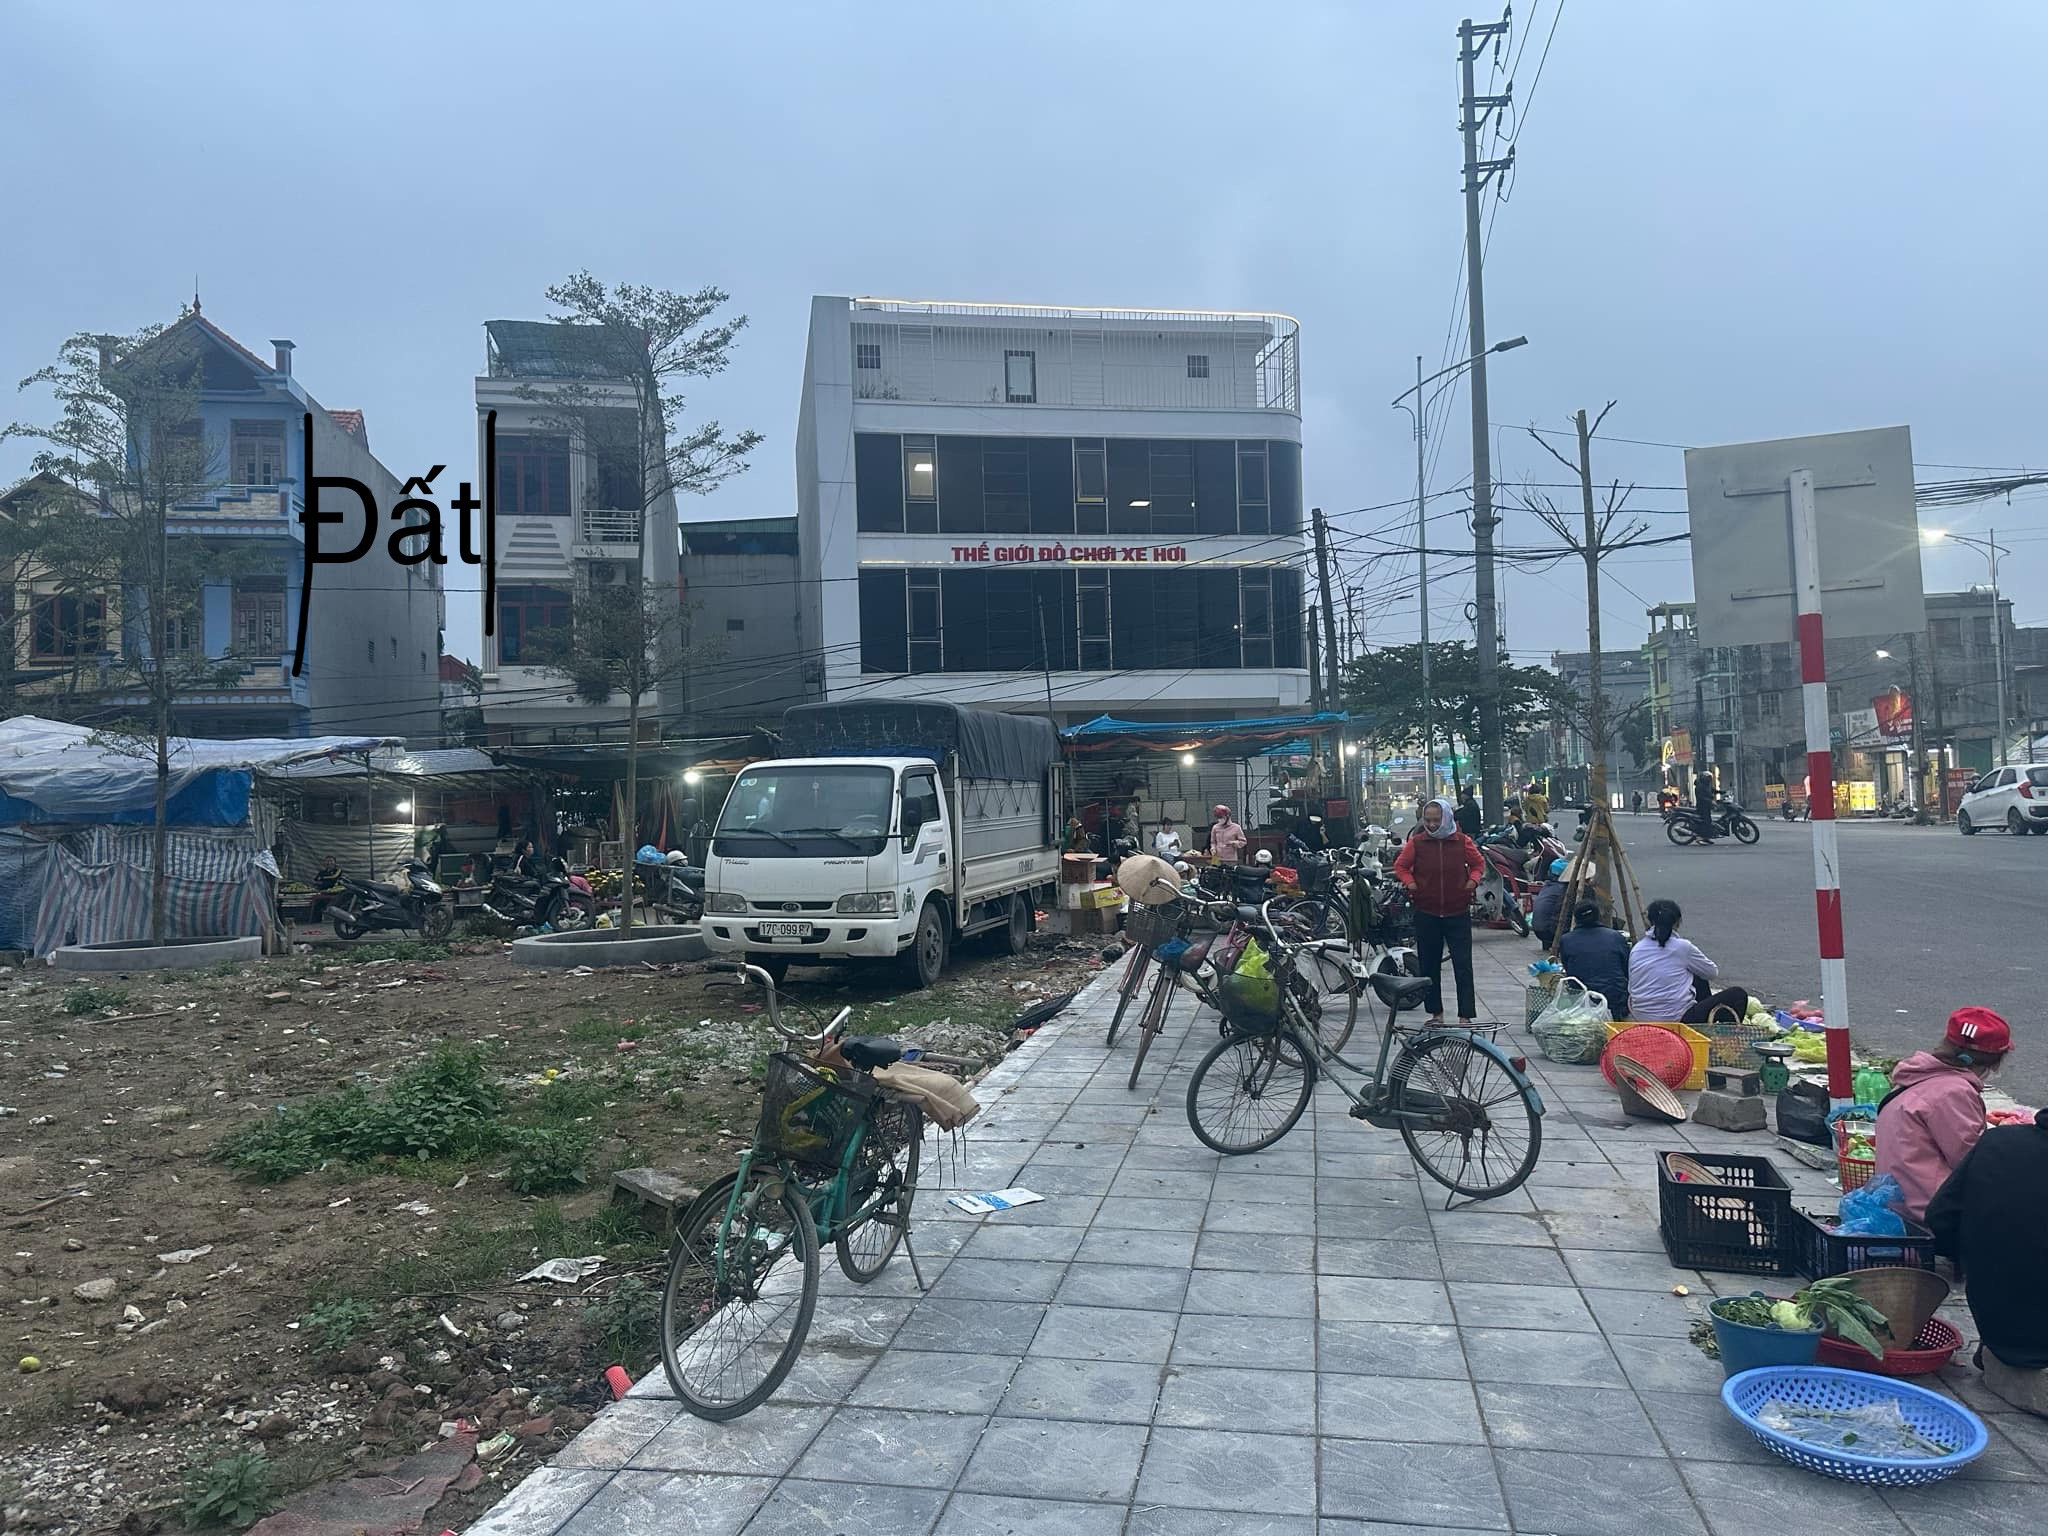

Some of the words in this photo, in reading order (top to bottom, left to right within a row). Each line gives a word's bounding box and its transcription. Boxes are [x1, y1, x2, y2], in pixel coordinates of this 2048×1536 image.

[952, 541, 990, 561] THẾ
[994, 544, 1034, 561] GIỚI
[1039, 541, 1066, 561] ĐỒ
[1070, 546, 1117, 561] CHƠI
[1121, 547, 1148, 561] XE
[1153, 546, 1187, 561] HƠI
